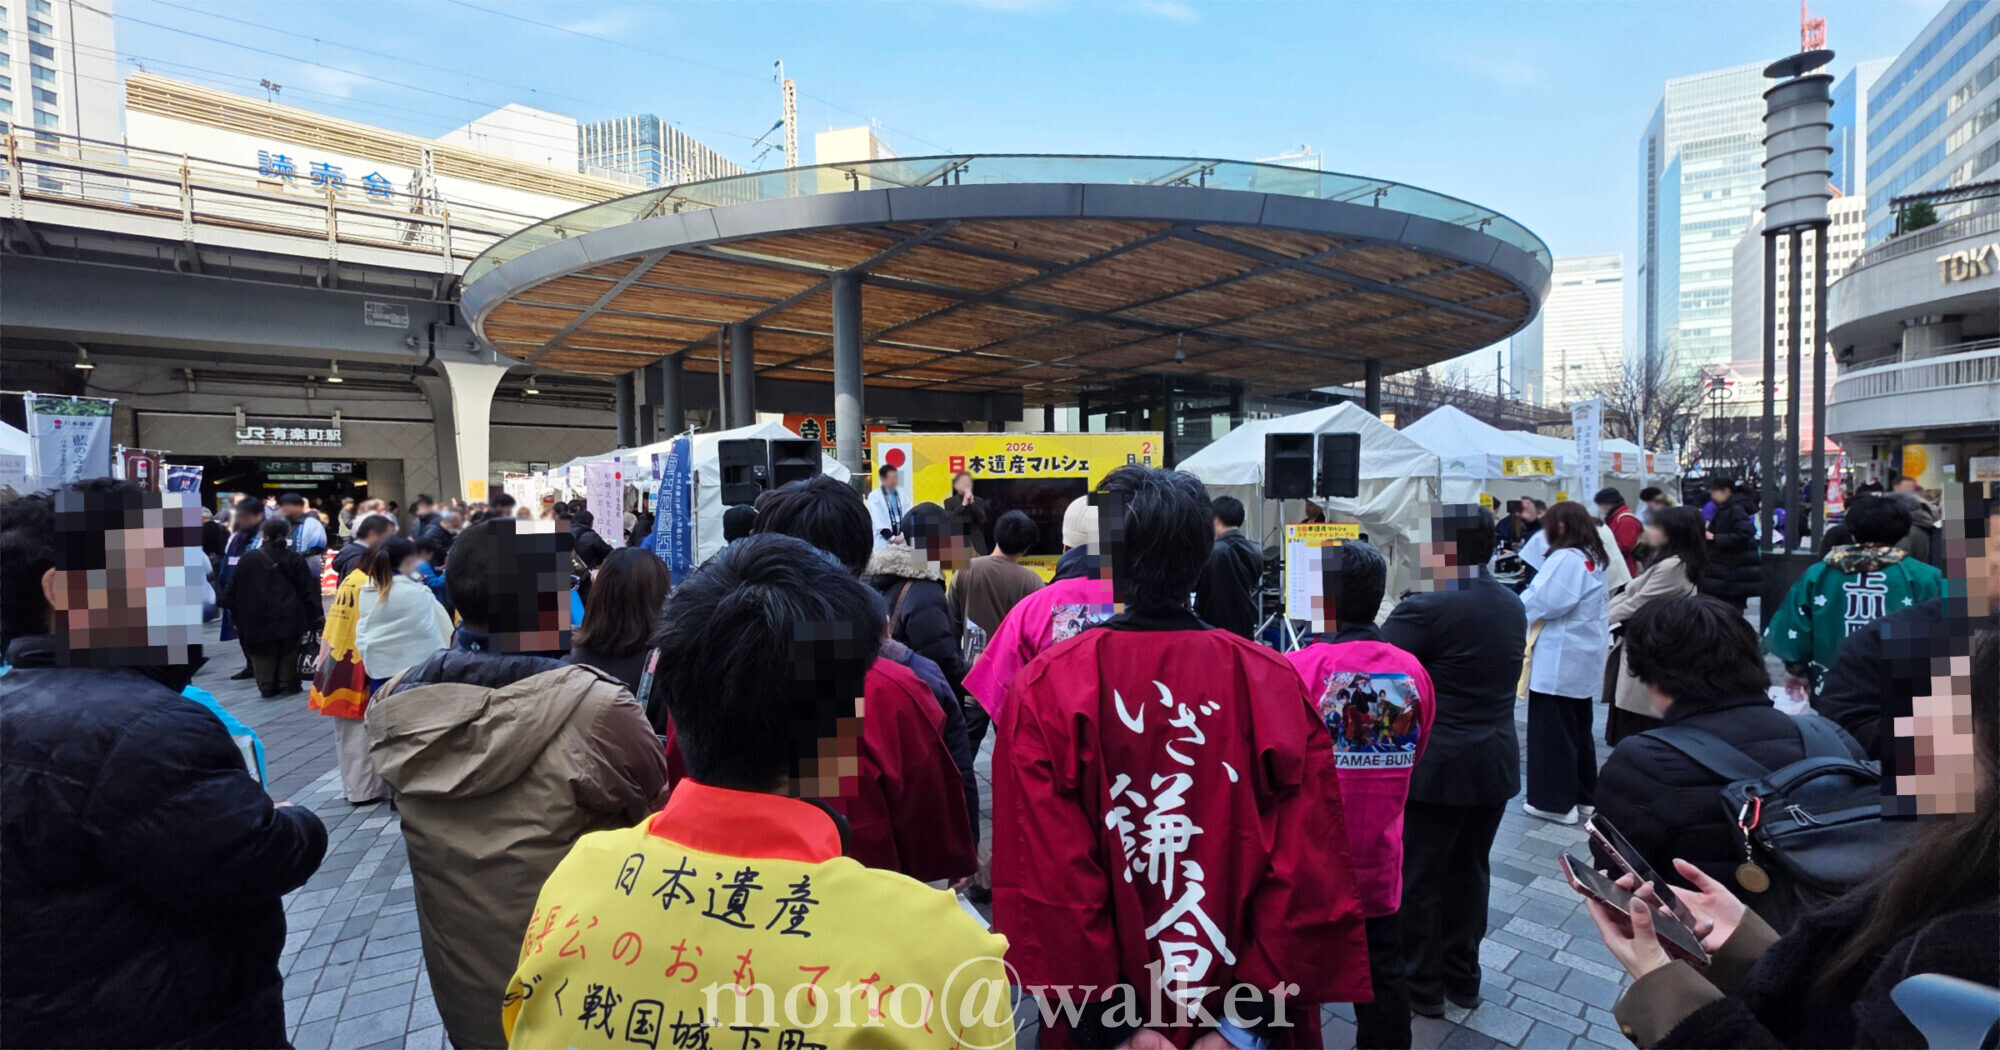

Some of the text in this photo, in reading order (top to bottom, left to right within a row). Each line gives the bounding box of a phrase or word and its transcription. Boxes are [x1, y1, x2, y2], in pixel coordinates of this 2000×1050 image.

[236, 426, 341, 441] JR 有楽町駅
[1005, 442, 1035, 452] 2026
[949, 454, 1090, 475] 日本遺産マルシェ
[1113, 679, 1239, 783] いざ、
[614, 853, 820, 938] 日本遺産
[1104, 772, 1237, 1020] 鎌倉
